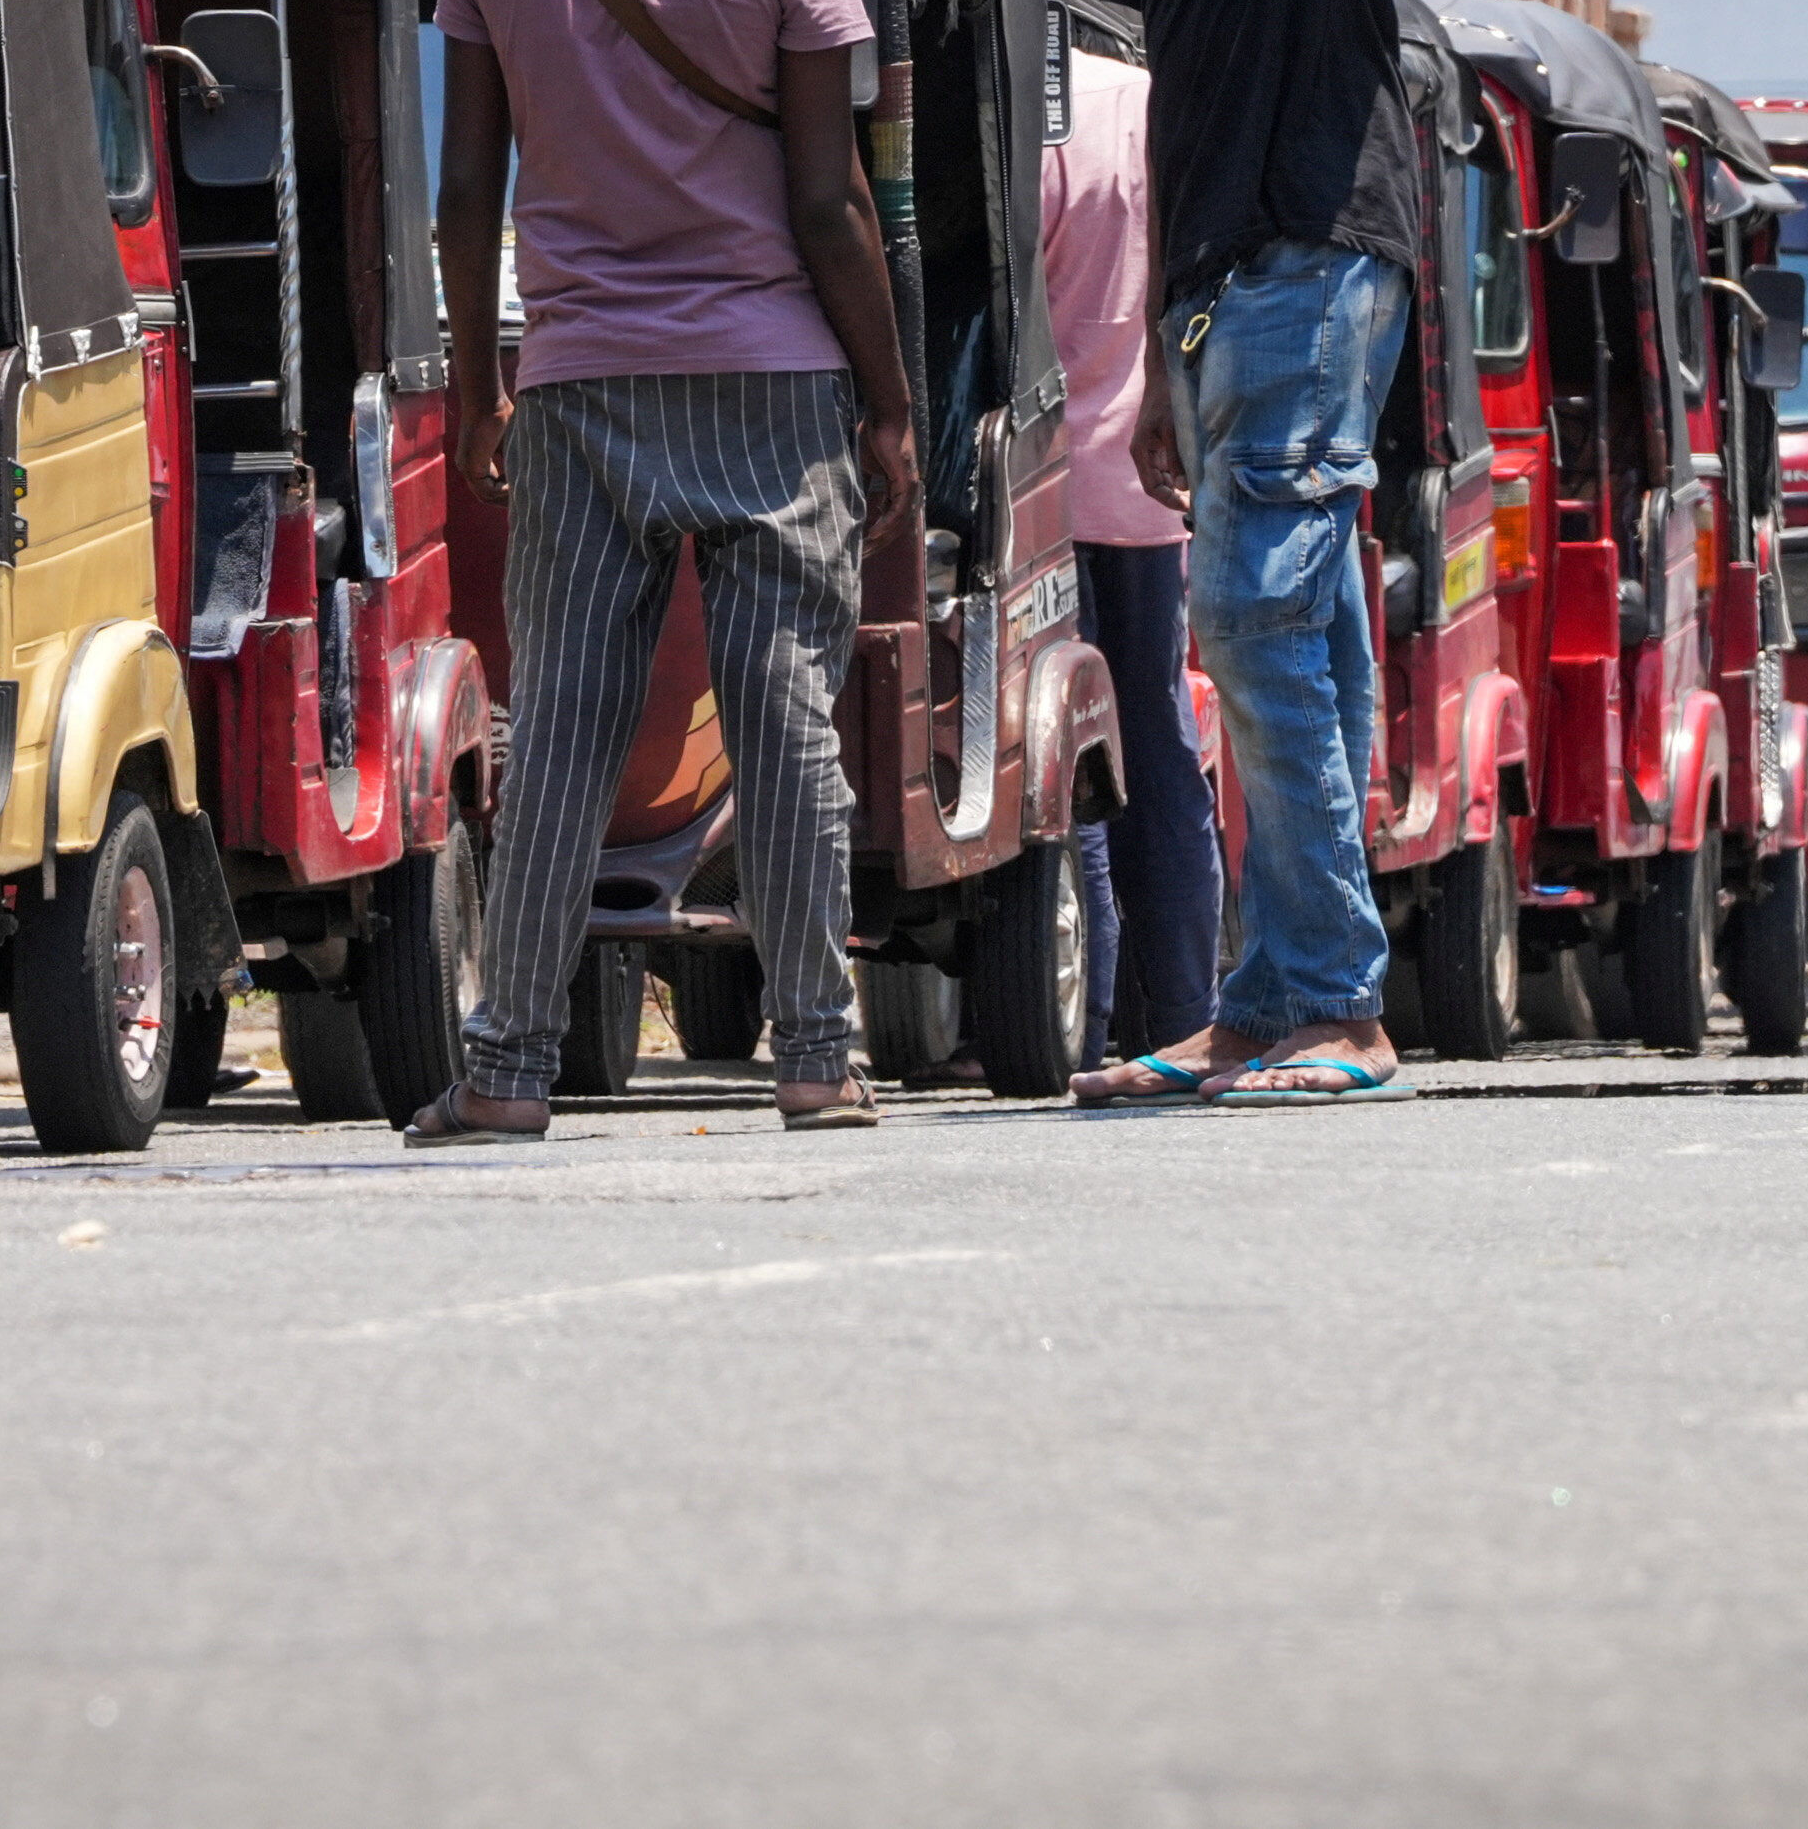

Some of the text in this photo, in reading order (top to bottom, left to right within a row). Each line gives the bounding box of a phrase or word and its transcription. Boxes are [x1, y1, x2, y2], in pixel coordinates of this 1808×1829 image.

[1044, 11, 1064, 133] THE OFF ROAD
